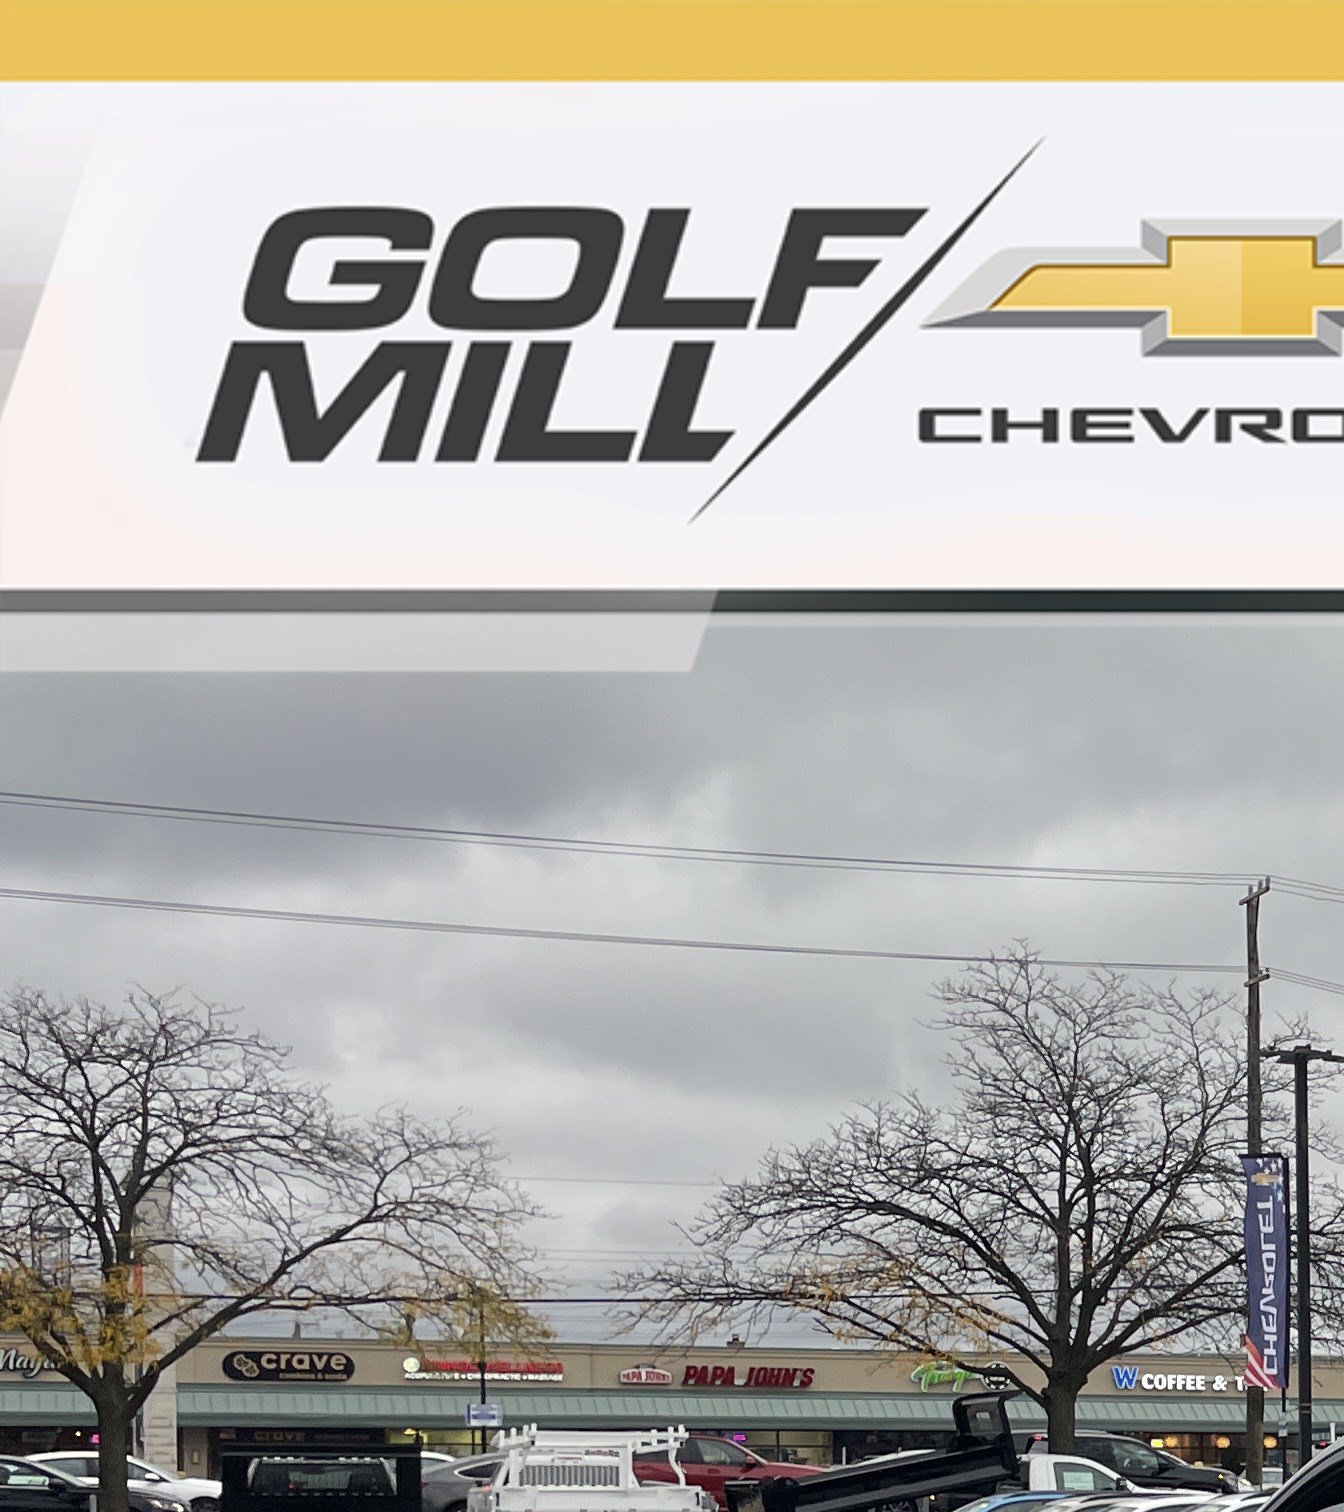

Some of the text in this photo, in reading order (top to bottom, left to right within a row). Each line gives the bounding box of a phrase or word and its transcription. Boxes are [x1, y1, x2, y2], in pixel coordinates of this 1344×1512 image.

[1256, 1195, 1279, 1376] CHEVROLET
[260, 1353, 348, 1371] crave
[682, 1365, 816, 1389] PAPA JOHN'S
[1111, 1365, 1140, 1390] W
[1142, 1374, 1206, 1391] COFFEE
[1212, 1375, 1227, 1391] &
